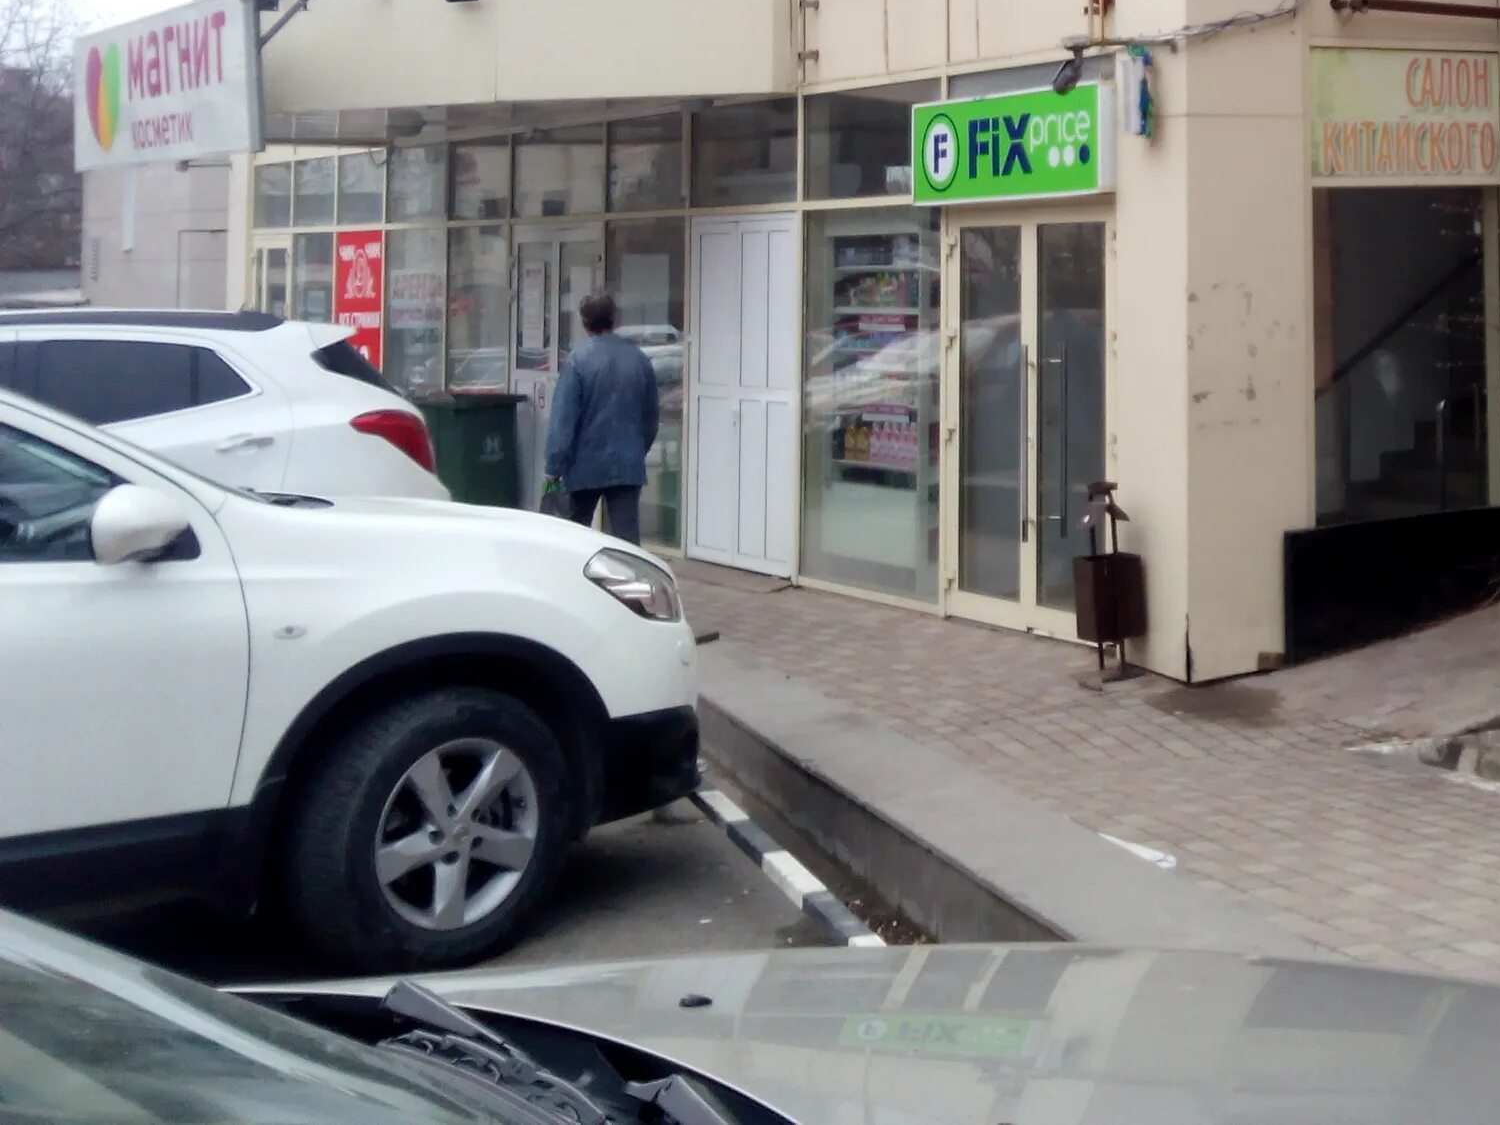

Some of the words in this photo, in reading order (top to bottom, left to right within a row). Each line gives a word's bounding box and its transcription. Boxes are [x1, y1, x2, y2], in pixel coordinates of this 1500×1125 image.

[1406, 57, 1489, 108] САЛОН
[1030, 110, 1091, 153] price
[1322, 115, 1496, 175] КИТАЙСКОГО
